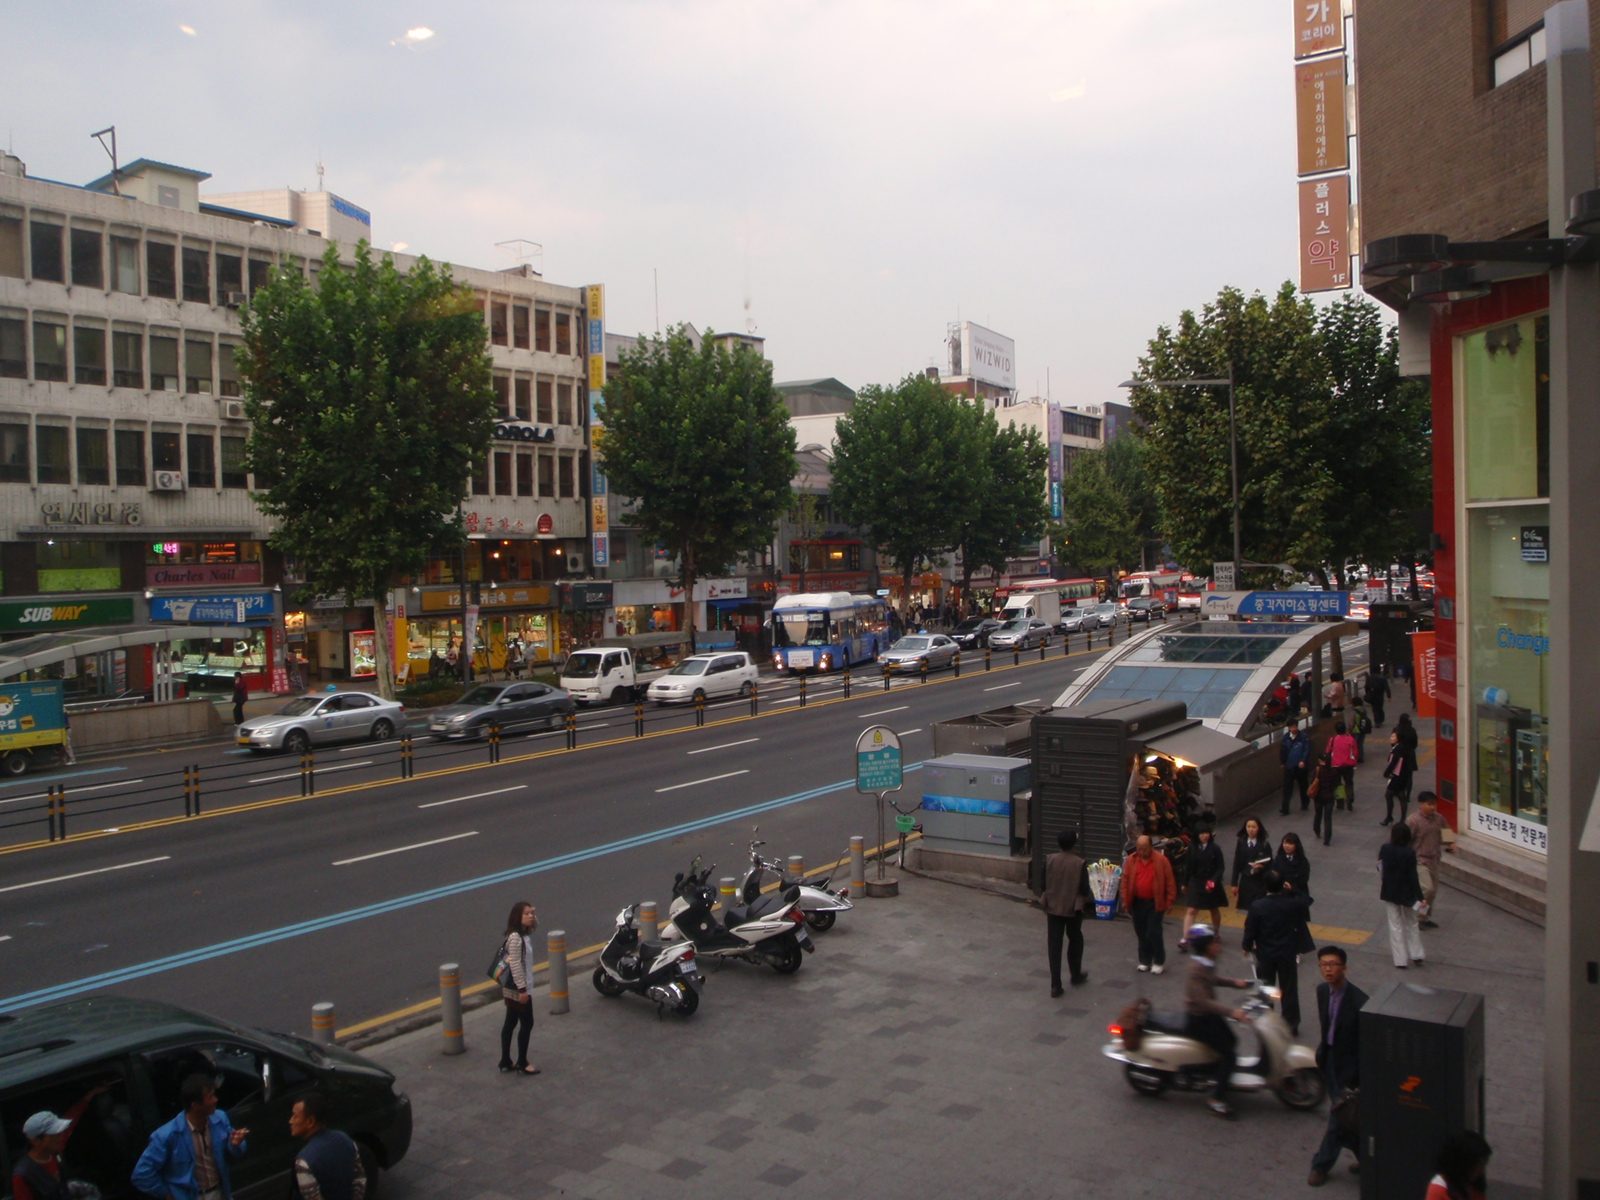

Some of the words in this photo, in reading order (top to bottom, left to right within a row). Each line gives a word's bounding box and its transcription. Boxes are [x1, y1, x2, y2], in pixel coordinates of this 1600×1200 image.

[1301, 25, 1336, 42] 코리아
[1314, 182, 1331, 236] 플러스
[1331, 273, 1345, 284] 1F
[974, 346, 1010, 372] WIZWID
[494, 424, 555, 442] OROLA
[41, 502, 141, 525] 연세안경
[154, 570, 203, 584] Charles
[209, 569, 236, 581] Nail
[19, 605, 87, 623] SUBWAY
[1254, 600, 1339, 612] 종각지하쇼핑센터
[1478, 812, 1517, 844] 누진다초점
[1520, 825, 1547, 855] 전문점
